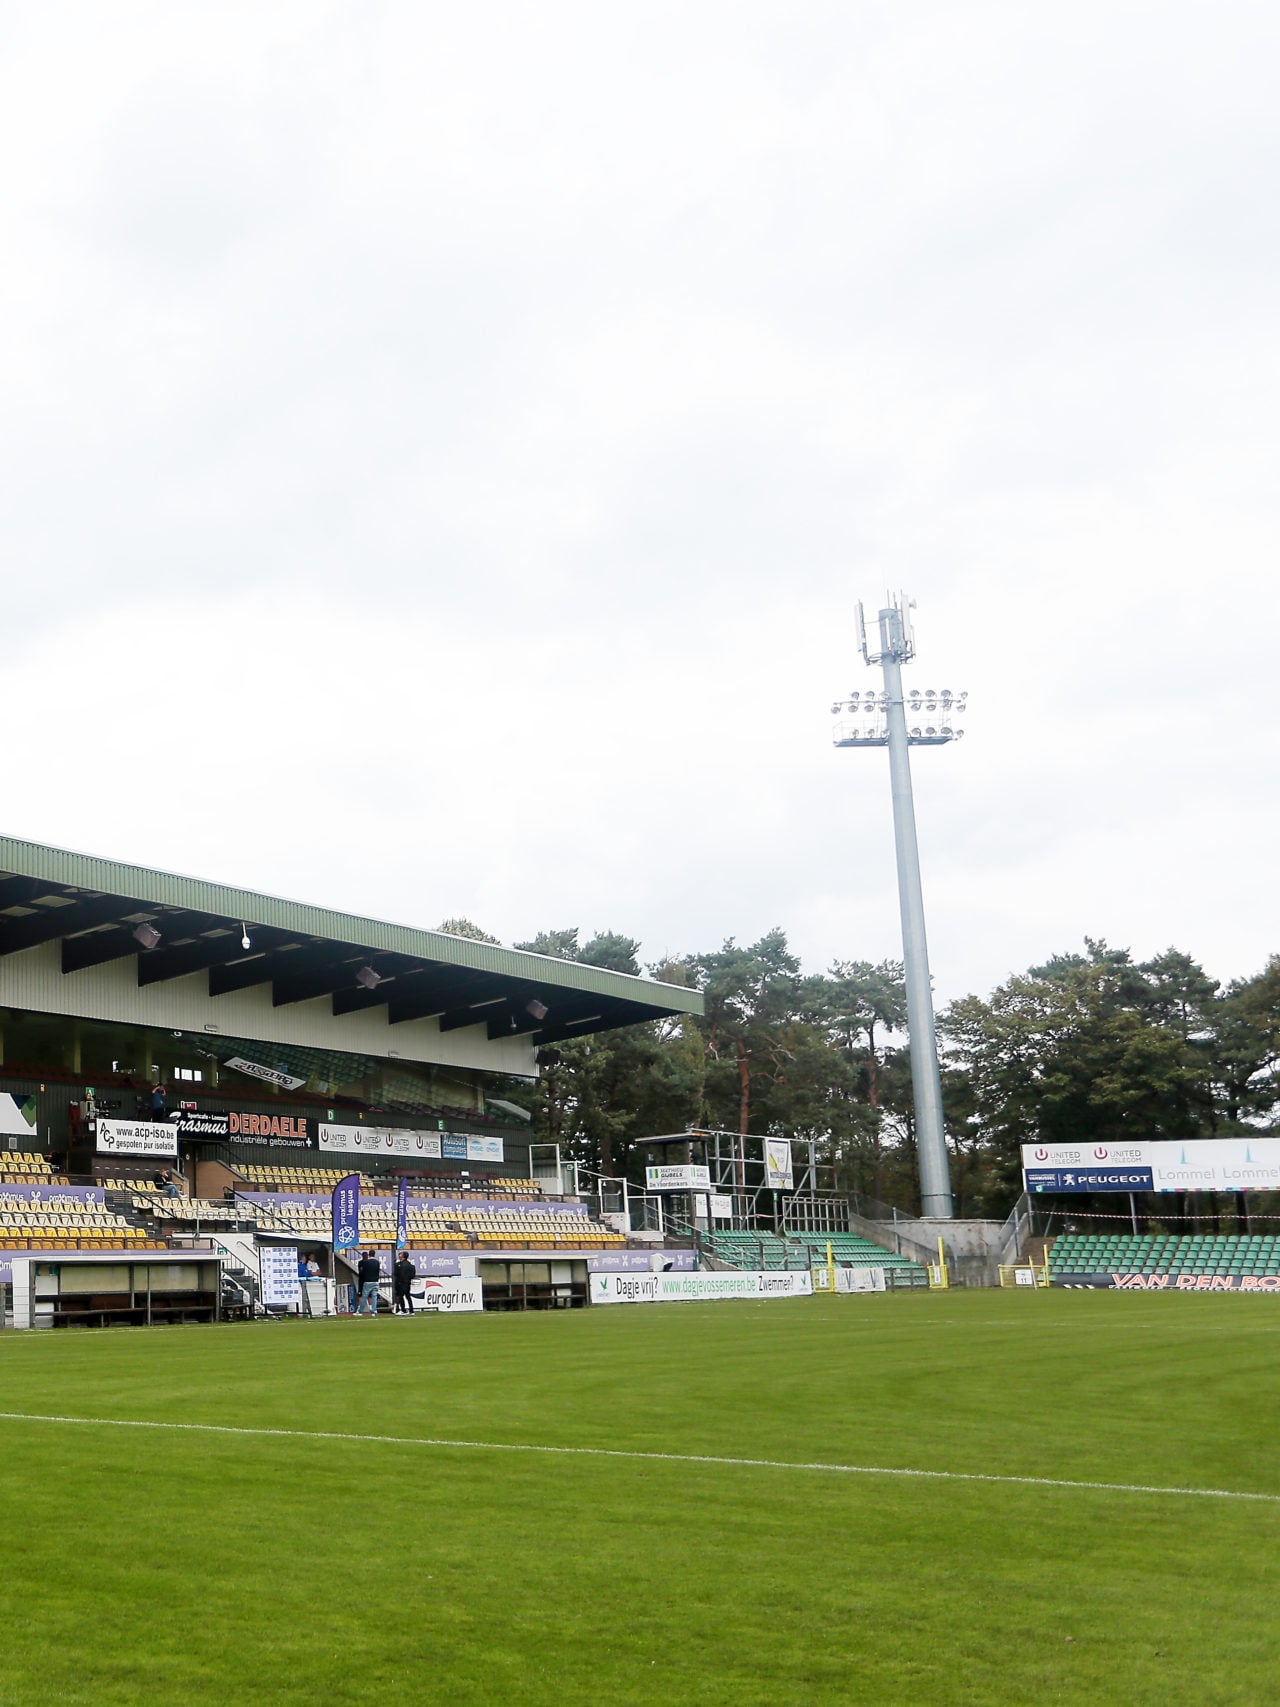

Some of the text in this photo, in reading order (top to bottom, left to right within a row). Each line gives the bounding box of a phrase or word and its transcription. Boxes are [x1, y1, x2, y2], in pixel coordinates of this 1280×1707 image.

[229, 1112, 307, 1138] DERDAELE
[115, 1126, 175, 1140] www.acp-iso.be
[269, 1137, 305, 1147] gebouwen
[1050, 1151, 1081, 1159] UNITED
[1109, 1149, 1141, 1157] UNITED
[1158, 1167, 1216, 1180] Lommel
[1223, 1166, 1280, 1179] Lomme
[1077, 1175, 1150, 1184] PEUGEOT
[339, 1190, 347, 1225] proximus
[346, 1190, 355, 1216] League
[1111, 1274, 1169, 1287] VAN
[1176, 1275, 1233, 1287] DEN
[616, 1277, 640, 1299] Dagje
[641, 1277, 659, 1299] vrij?
[427, 1289, 476, 1308] eurogri n.v.
